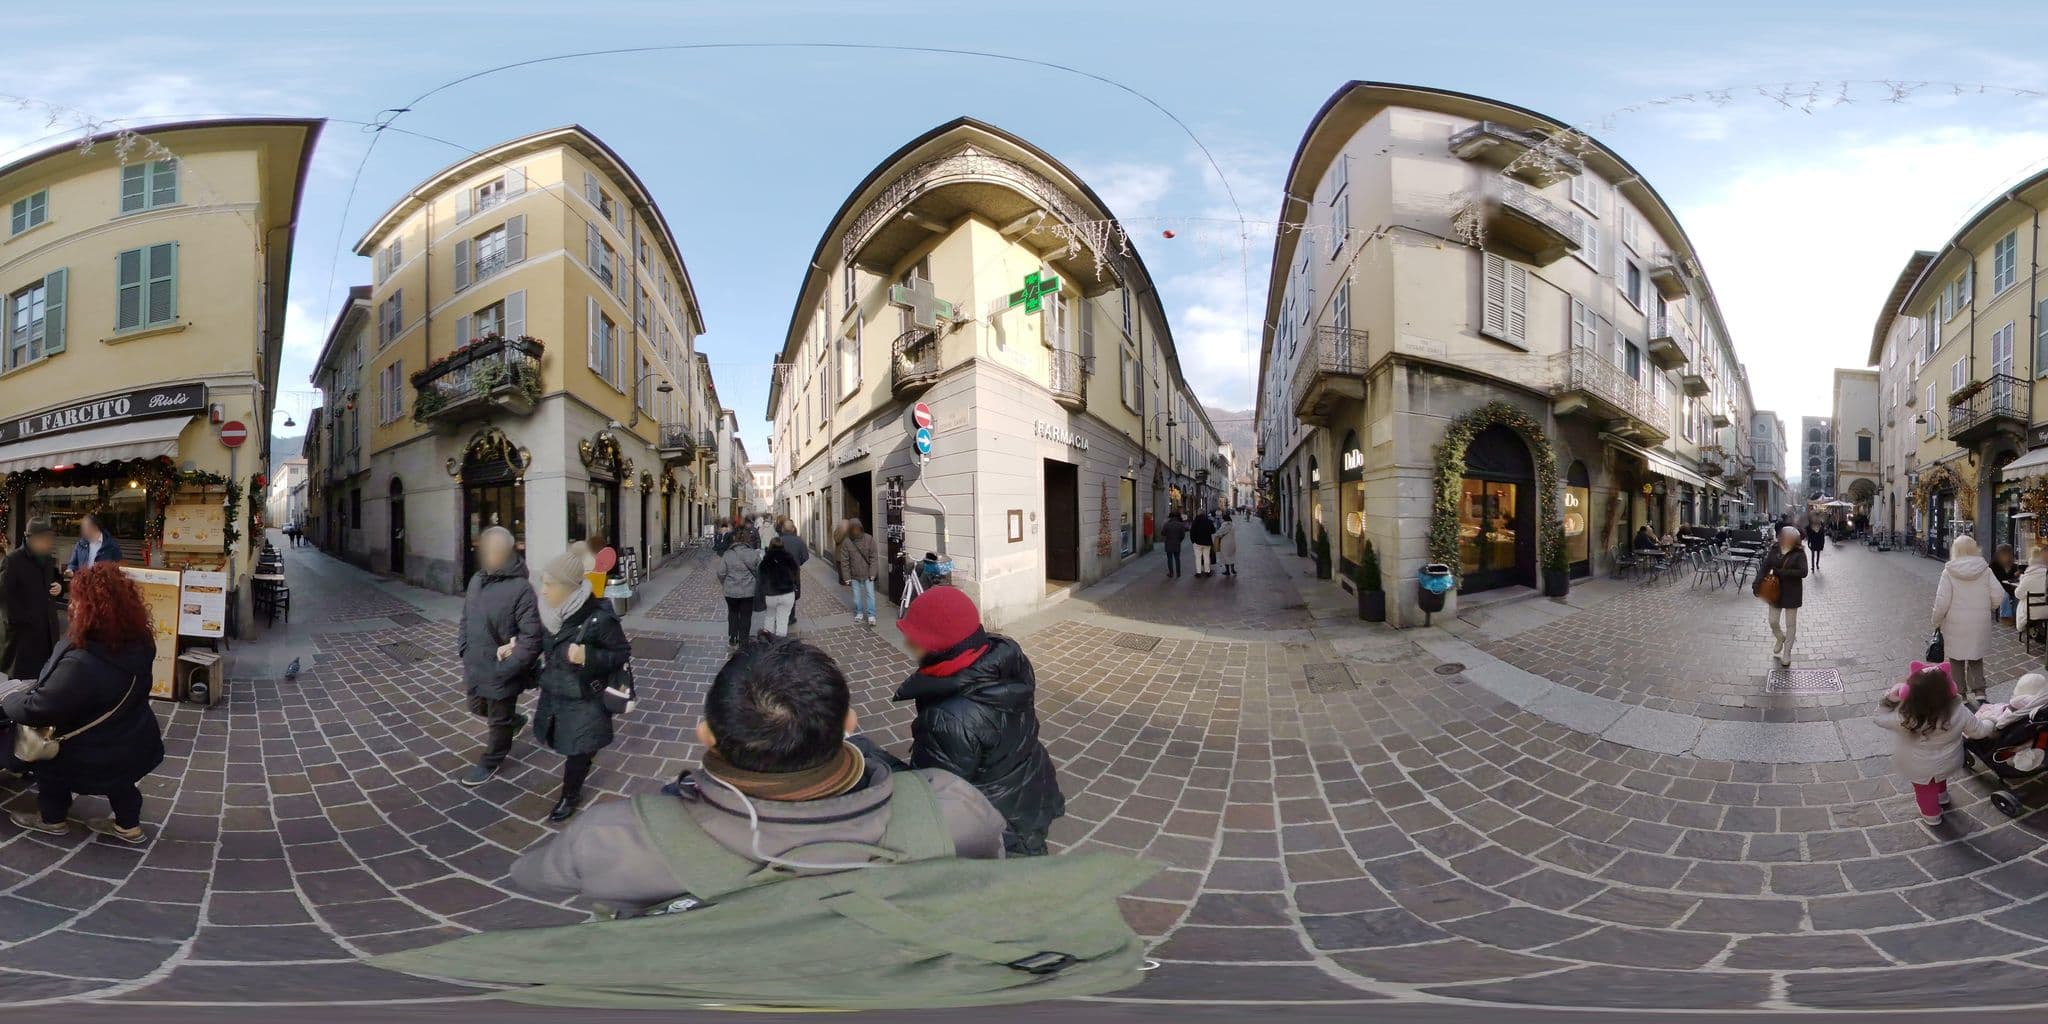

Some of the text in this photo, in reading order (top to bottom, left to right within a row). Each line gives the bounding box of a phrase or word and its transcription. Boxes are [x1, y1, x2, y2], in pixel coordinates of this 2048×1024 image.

[18, 421, 34, 437] IL
[41, 398, 131, 430] FARCITO
[1038, 419, 1089, 452] FARMACIA
